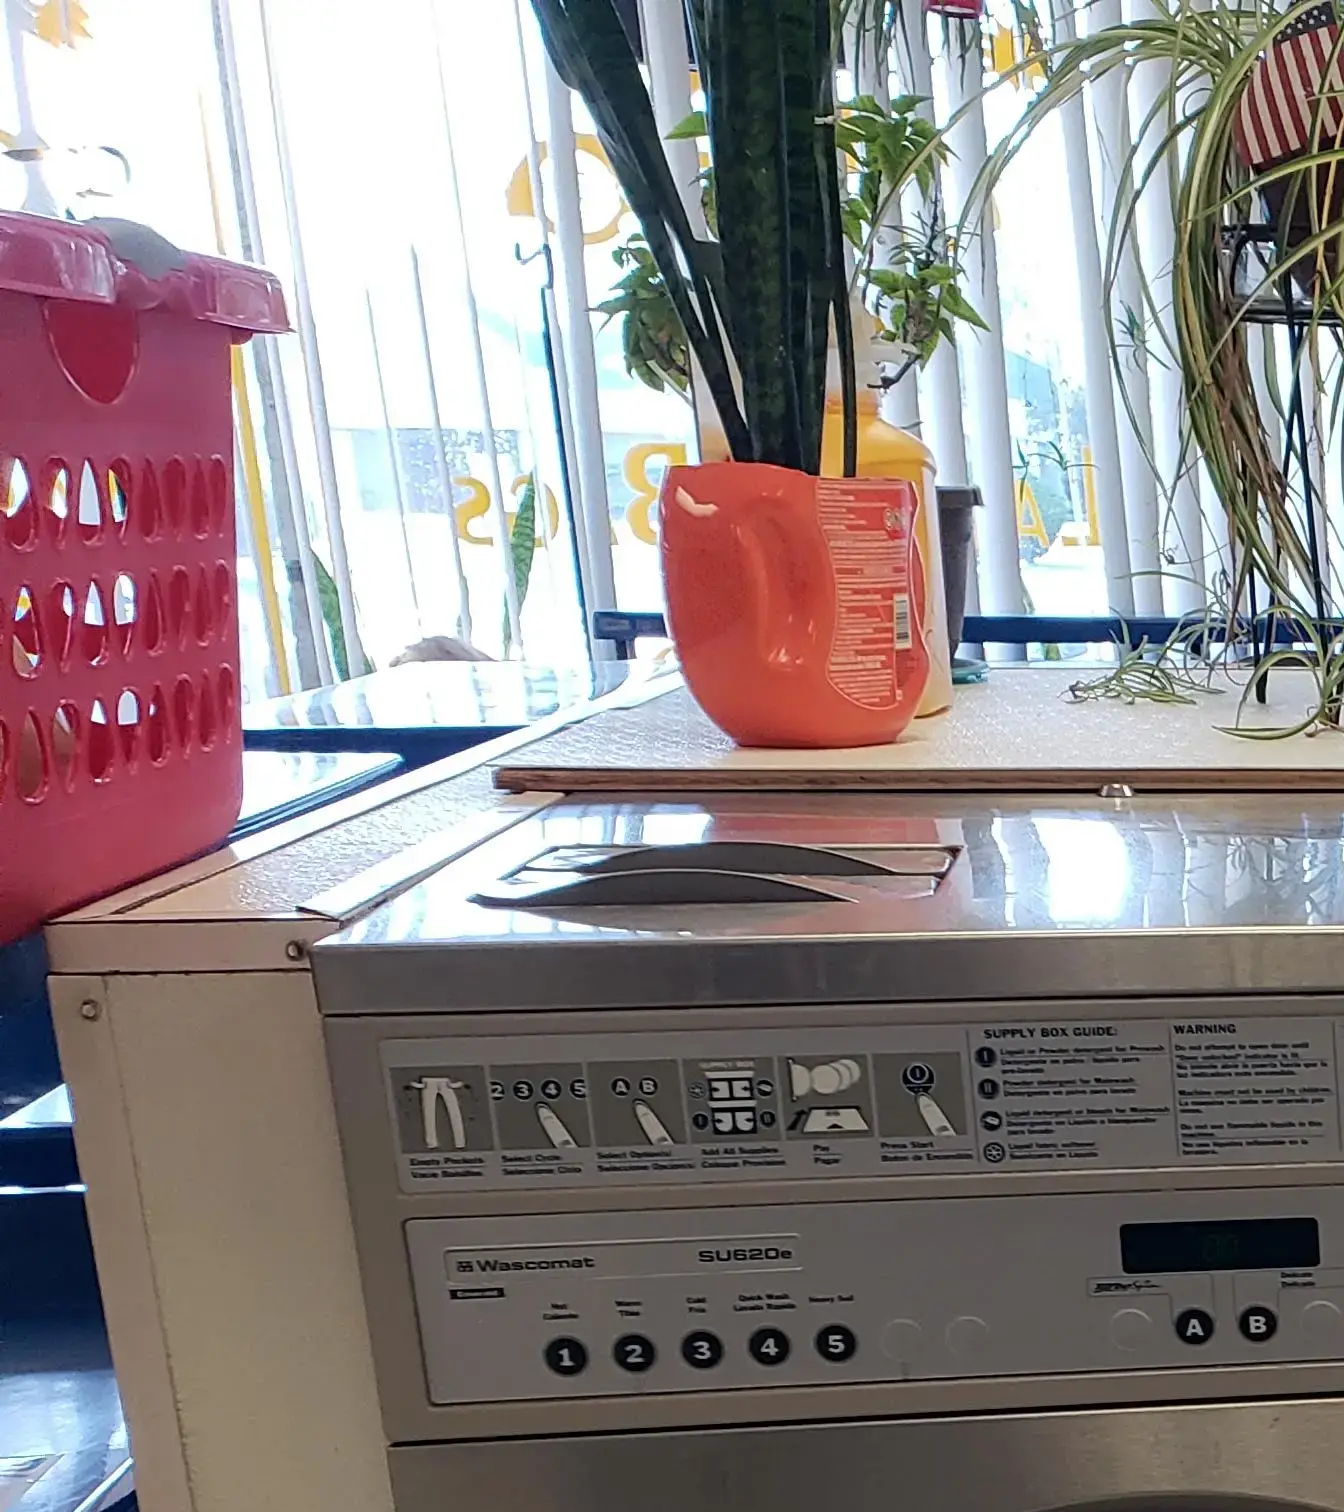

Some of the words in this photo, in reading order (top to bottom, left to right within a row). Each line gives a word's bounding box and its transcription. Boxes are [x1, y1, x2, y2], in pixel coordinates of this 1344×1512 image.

[983, 1028, 1036, 1039] SUPPLY
[1040, 1027, 1070, 1037] BOX
[1073, 1026, 1118, 1037] GUIDE:
[1173, 1023, 1237, 1035] WARNING
[517, 1083, 530, 1097] 3
[545, 1082, 559, 1097] 4
[615, 1080, 628, 1095] A
[643, 1079, 655, 1094] B
[698, 1246, 793, 1263] SU620e
[476, 1255, 595, 1272] Wascomat
[1185, 1319, 1204, 1337] A
[1249, 1316, 1267, 1334] B
[557, 1347, 574, 1366] 1
[625, 1344, 643, 1362] 2
[693, 1341, 711, 1360] 3
[759, 1337, 779, 1357] 4
[828, 1335, 845, 1353] 5
